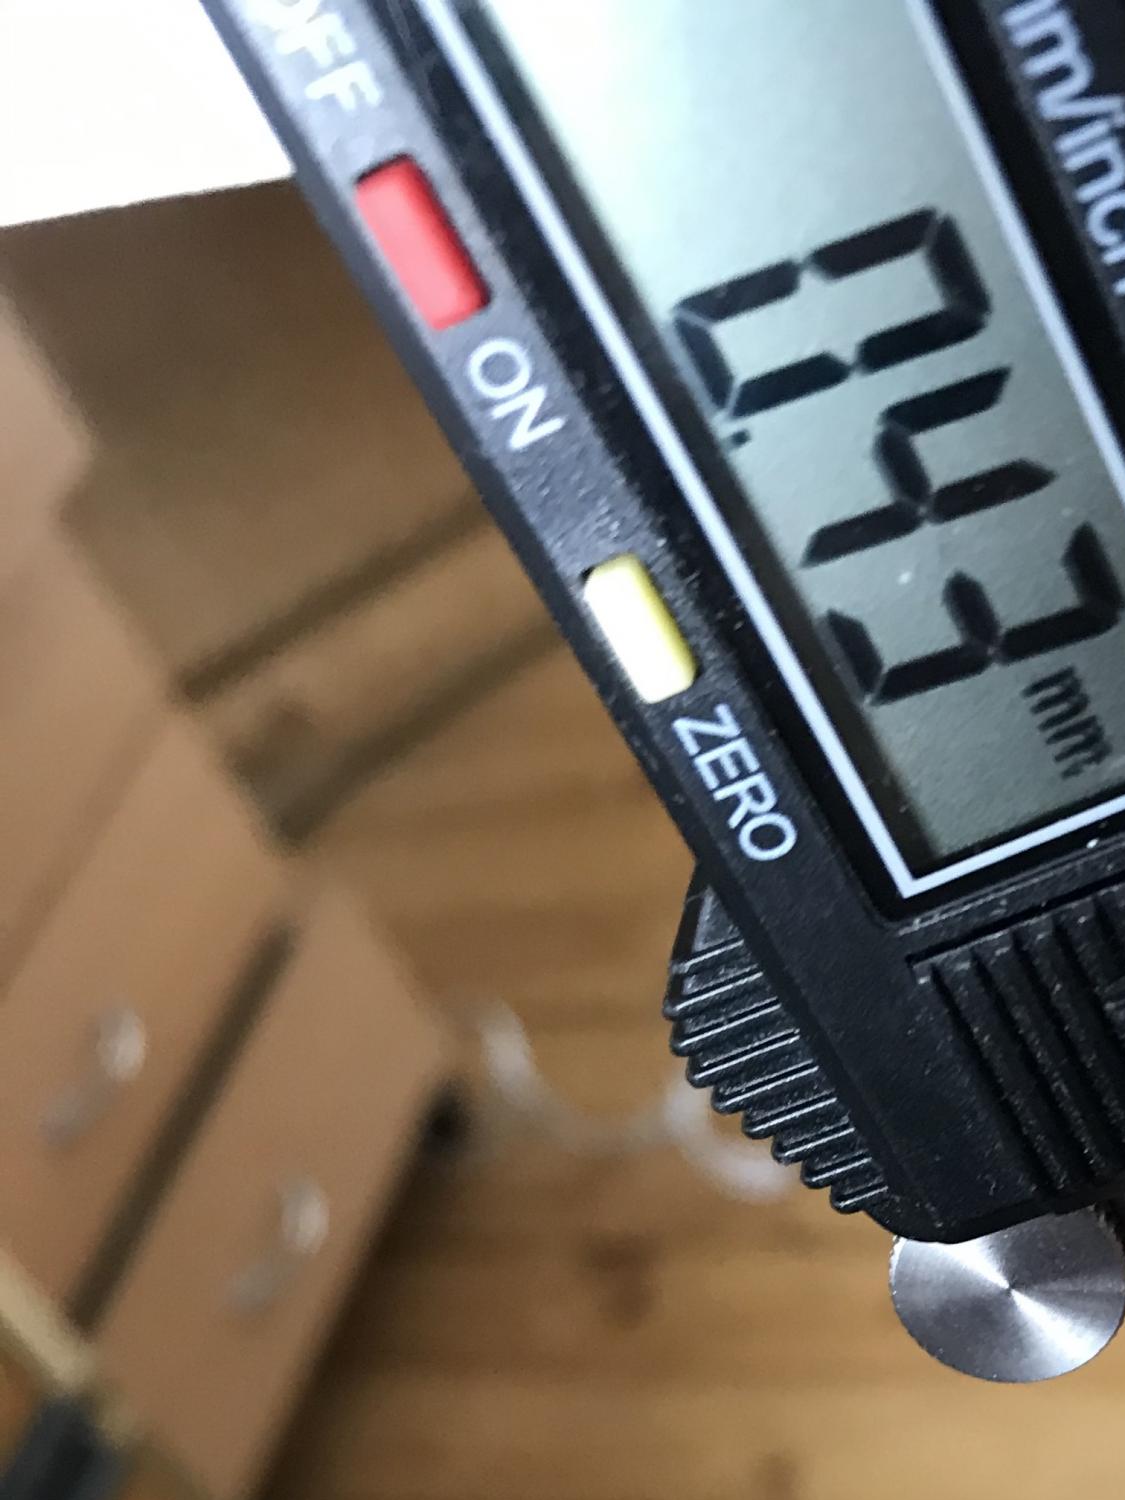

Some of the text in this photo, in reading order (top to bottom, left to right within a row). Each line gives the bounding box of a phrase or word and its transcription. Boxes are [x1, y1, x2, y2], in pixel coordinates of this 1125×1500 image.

[469, 338, 567, 451] ON
[1021, 665, 1113, 781] mm
[672, 703, 798, 861] ZERO
